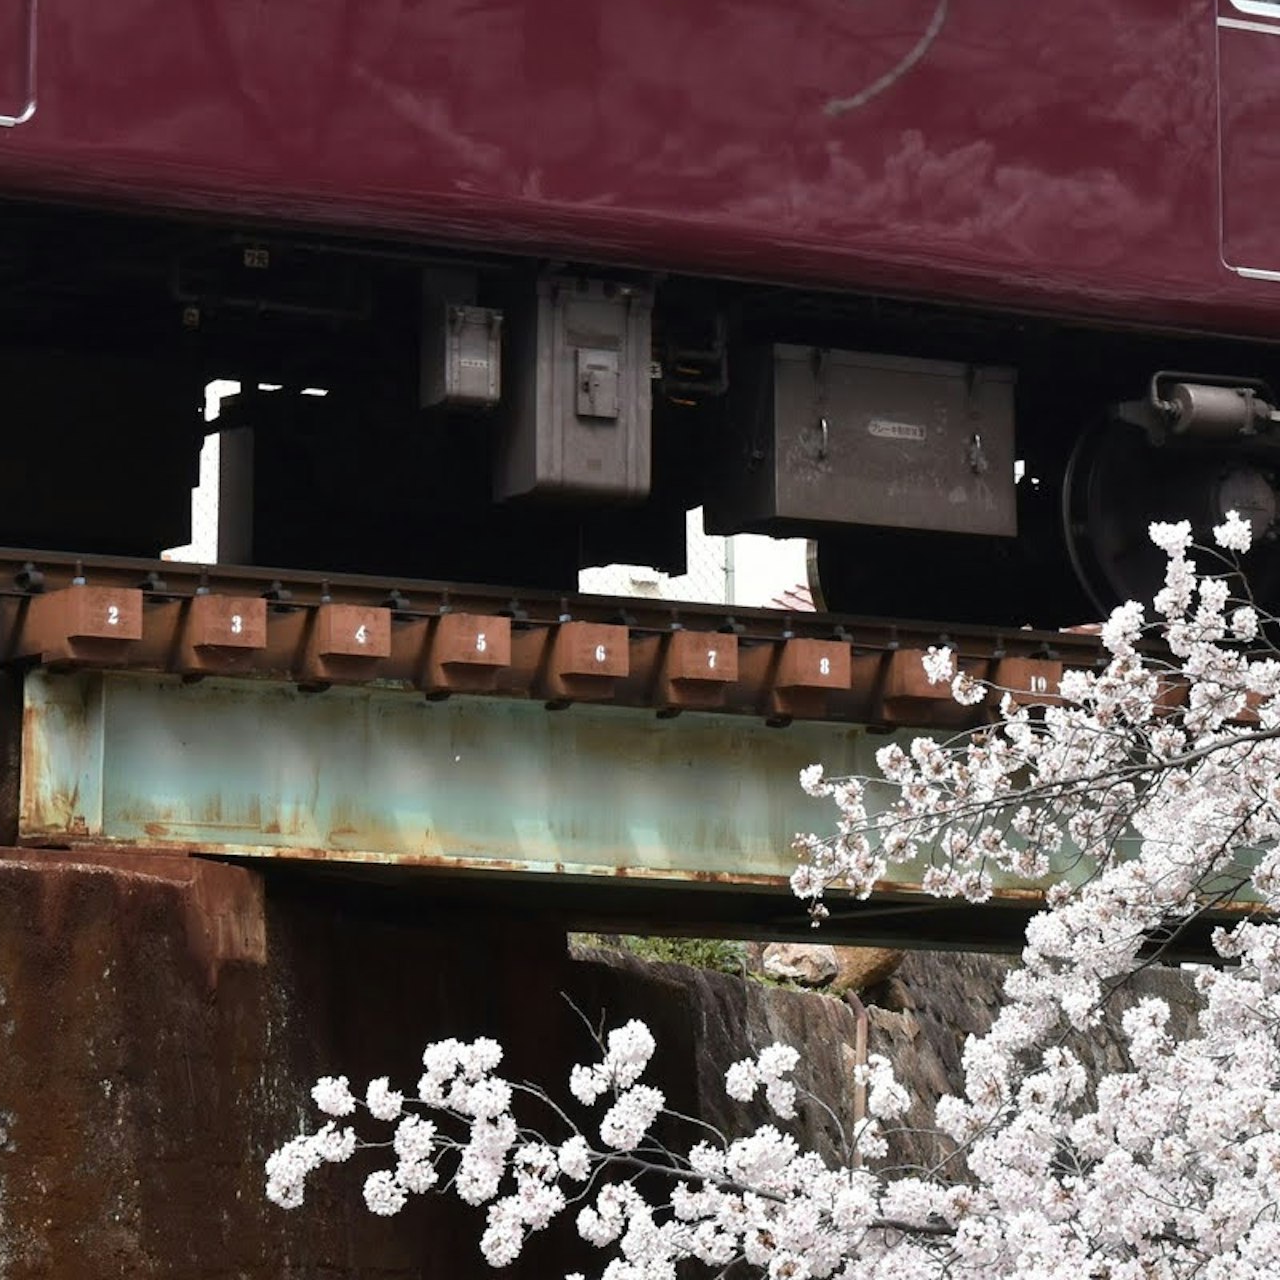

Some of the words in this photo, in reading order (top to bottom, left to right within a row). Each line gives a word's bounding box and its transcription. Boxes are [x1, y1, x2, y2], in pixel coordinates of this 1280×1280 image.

[107, 606, 120, 625] 2
[231, 615, 242, 633] 3
[355, 625, 367, 645] 4
[476, 633, 488, 652] 5
[595, 644, 606, 662] 6
[707, 650, 717, 669] 7
[819, 657, 830, 675] 8
[1030, 675, 1048, 693] 10
